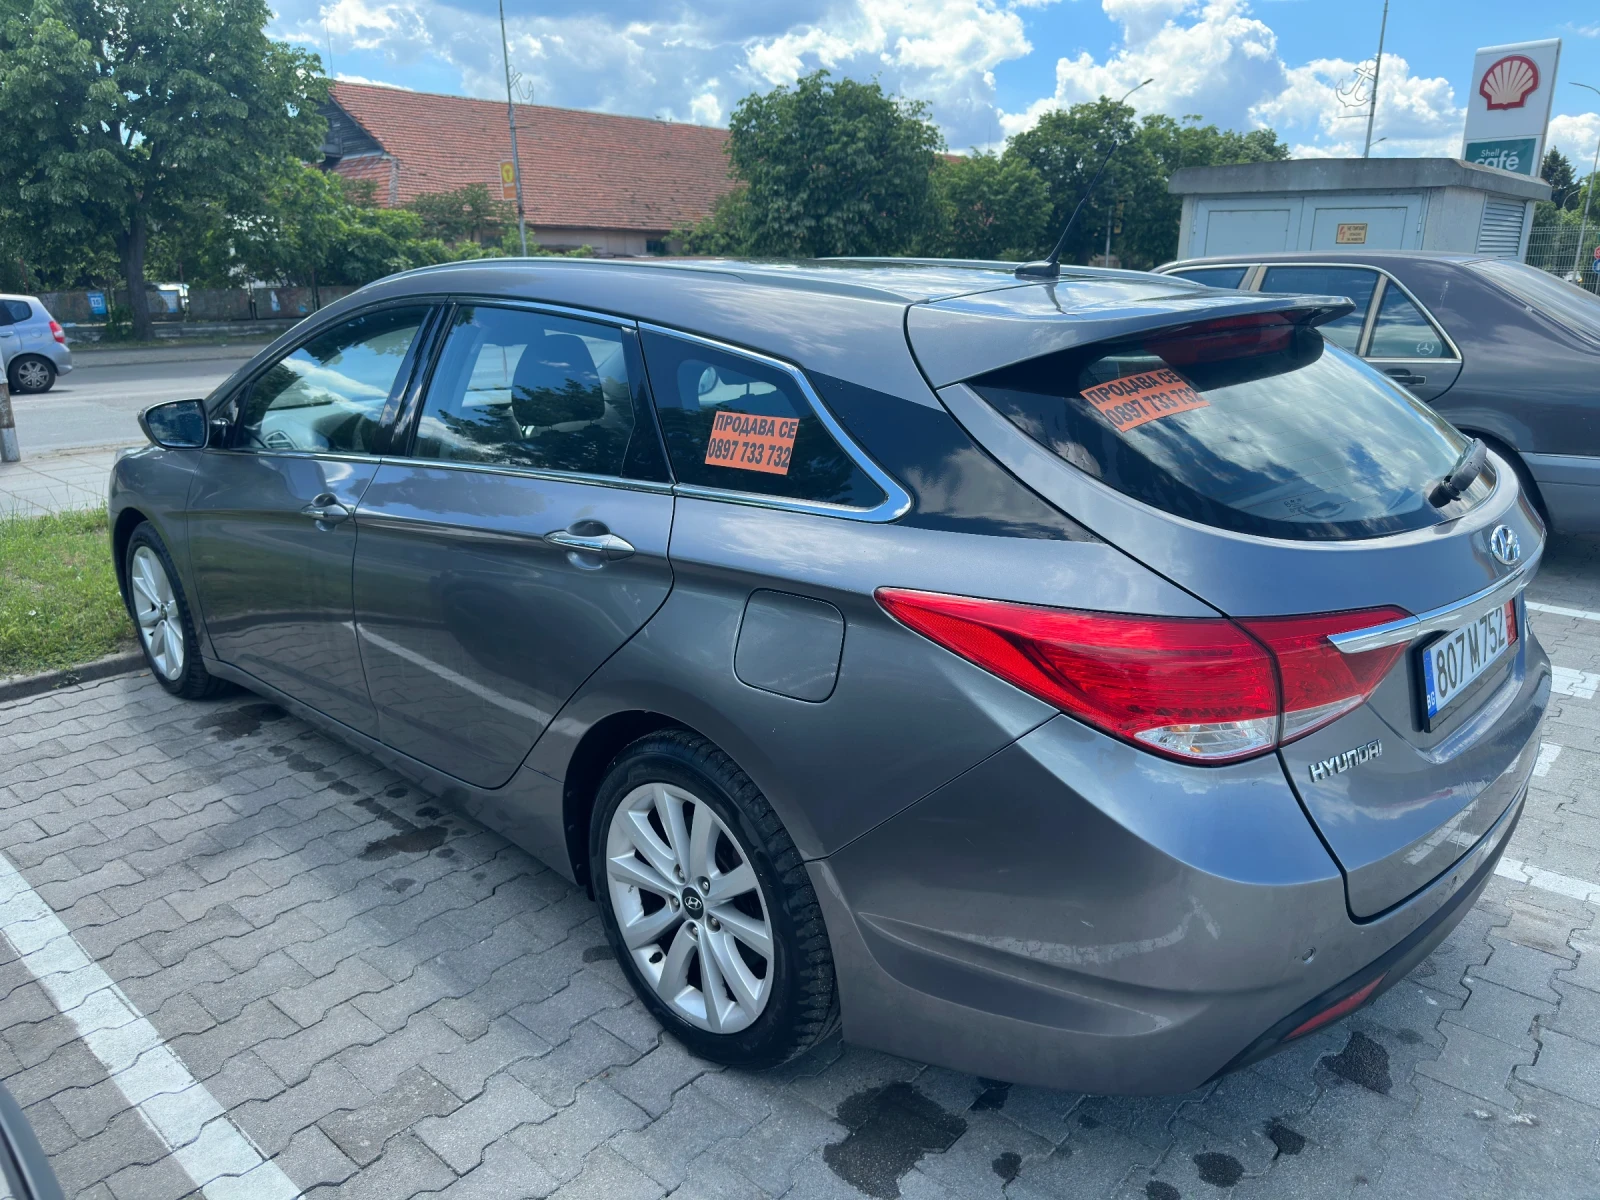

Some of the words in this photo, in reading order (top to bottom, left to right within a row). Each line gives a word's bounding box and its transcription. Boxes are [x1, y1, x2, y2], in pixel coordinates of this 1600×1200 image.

[1481, 148, 1500, 157] Shell
[1085, 374, 1163, 404] ПРОДАВА
[1160, 370, 1182, 384] СЕ
[1105, 399, 1149, 426] 0897
[1142, 392, 1179, 412] 733
[1169, 387, 1204, 405] 732
[714, 414, 776, 437] ПРОДАВА
[778, 421, 798, 439] СЕ
[708, 438, 739, 461] 0897
[740, 441, 765, 465] 733
[766, 444, 792, 469] 732
[1427, 691, 1436, 710] BG
[1309, 739, 1383, 783] HYUNDAI
